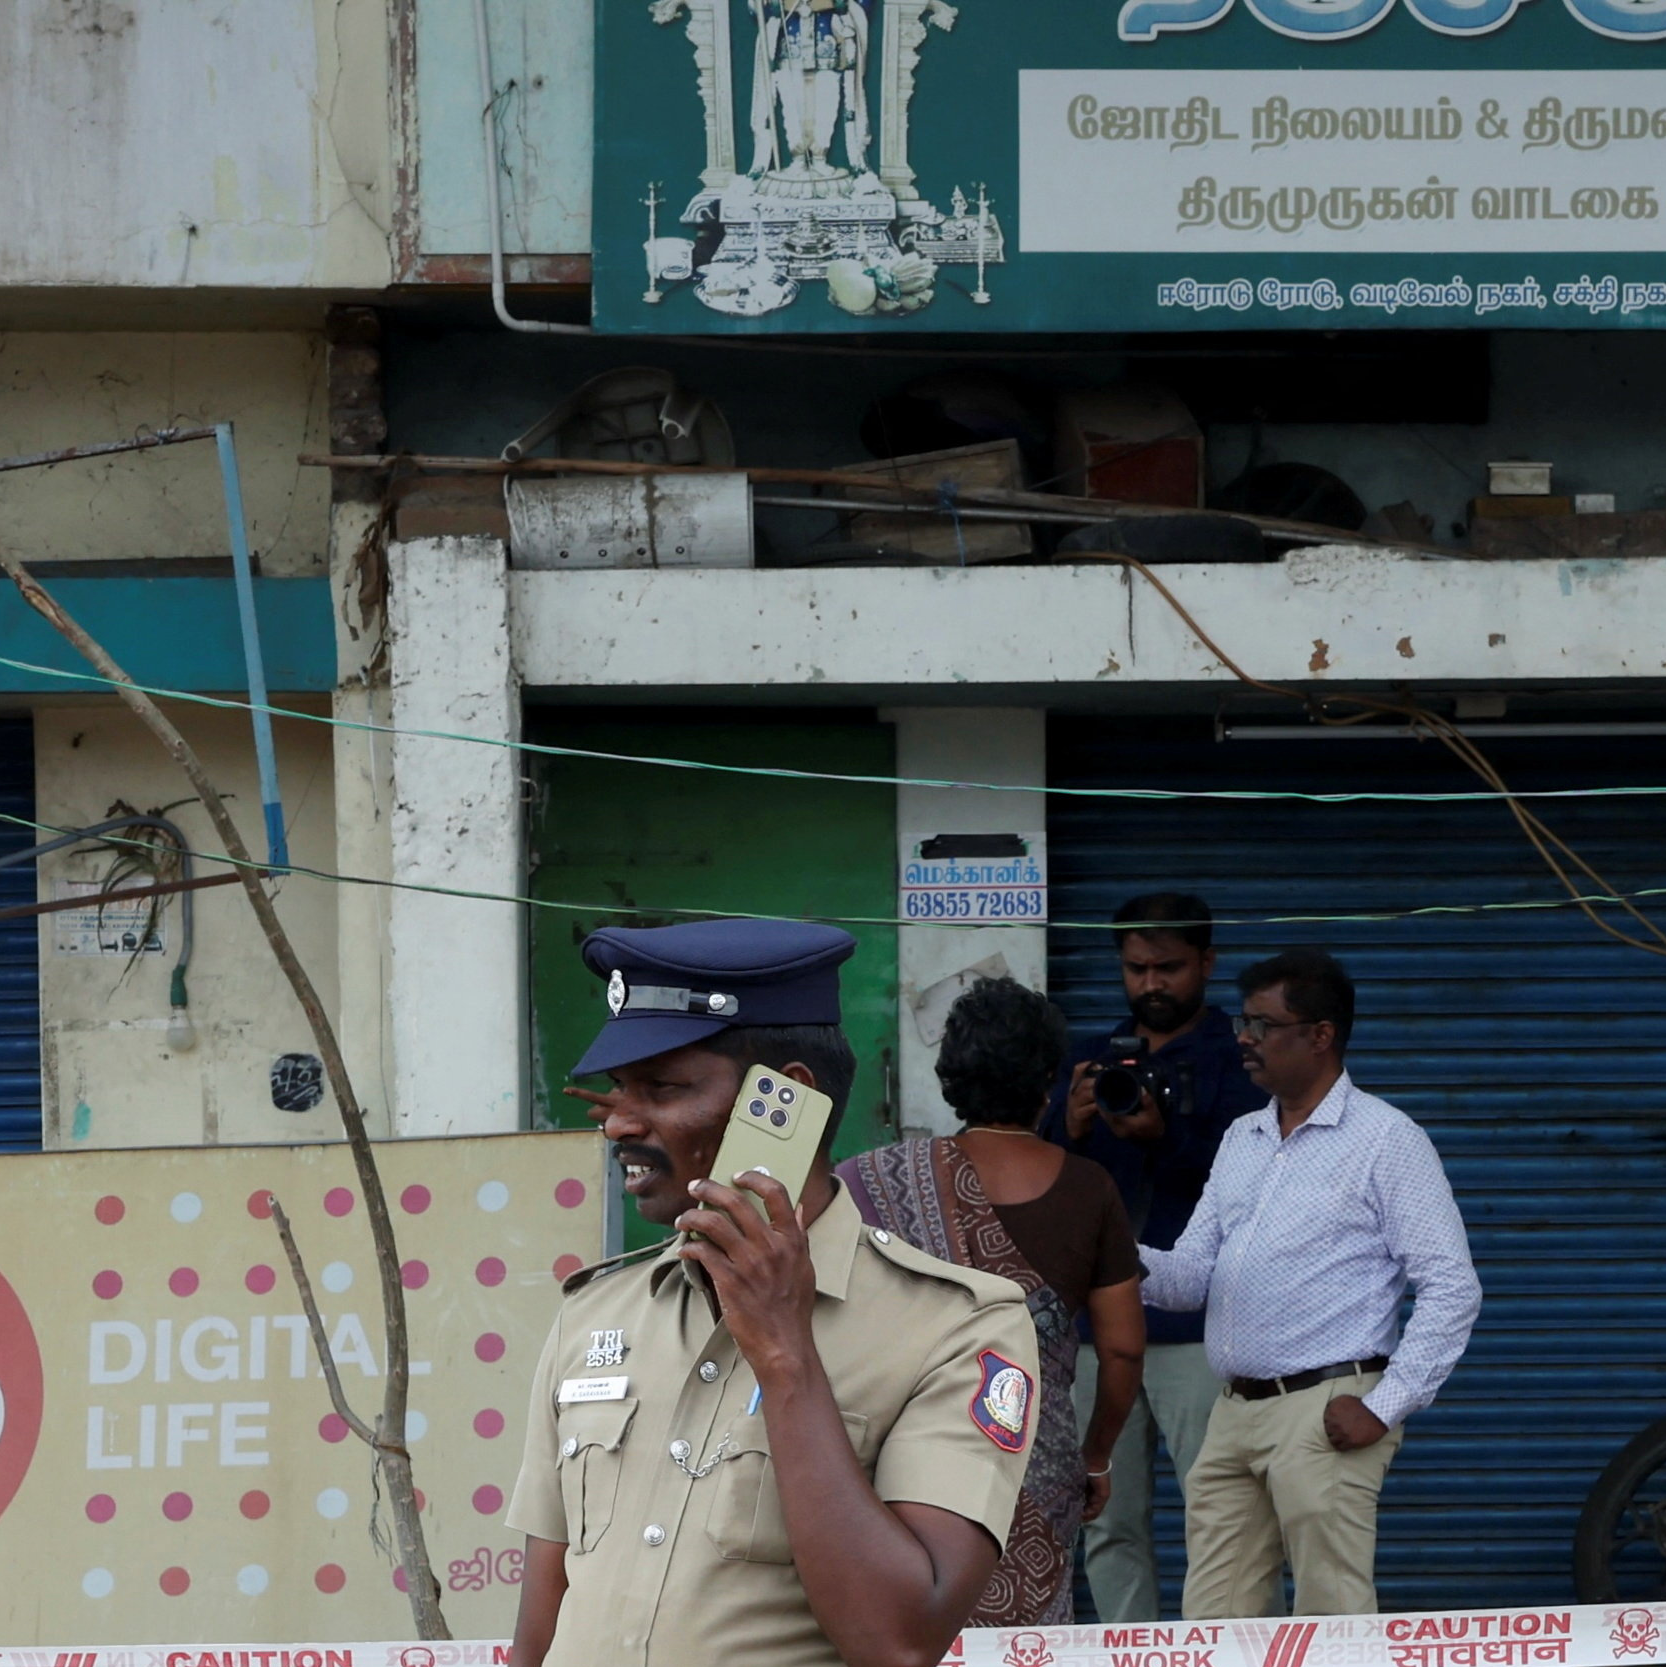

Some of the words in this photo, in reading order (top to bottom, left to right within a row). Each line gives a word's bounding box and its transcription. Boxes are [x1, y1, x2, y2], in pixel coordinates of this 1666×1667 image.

[1067, 93, 1239, 152] ஜோதிட
[1251, 96, 1463, 152] நிலையம்
[1475, 98, 1509, 140] &
[1177, 175, 1459, 233] திருமுருகன்
[1471, 183, 1659, 220] வாடகை
[1158, 277, 1253, 311] ஈரோடு
[1350, 275, 1472, 314] வடிவேல்
[1552, 275, 1618, 314] சக்தி
[905, 857, 1041, 884] மெக்கானிக்
[906, 893, 970, 917] 63855
[976, 891, 1042, 916] 72683
[89, 1313, 431, 1385] DIGITAL
[591, 1329, 624, 1349] TRI
[86, 1402, 270, 1470] LIFE
[1103, 1629, 1173, 1649] MEN
[1184, 1626, 1225, 1645] AT
[1386, 1612, 1571, 1641] CAUTION
